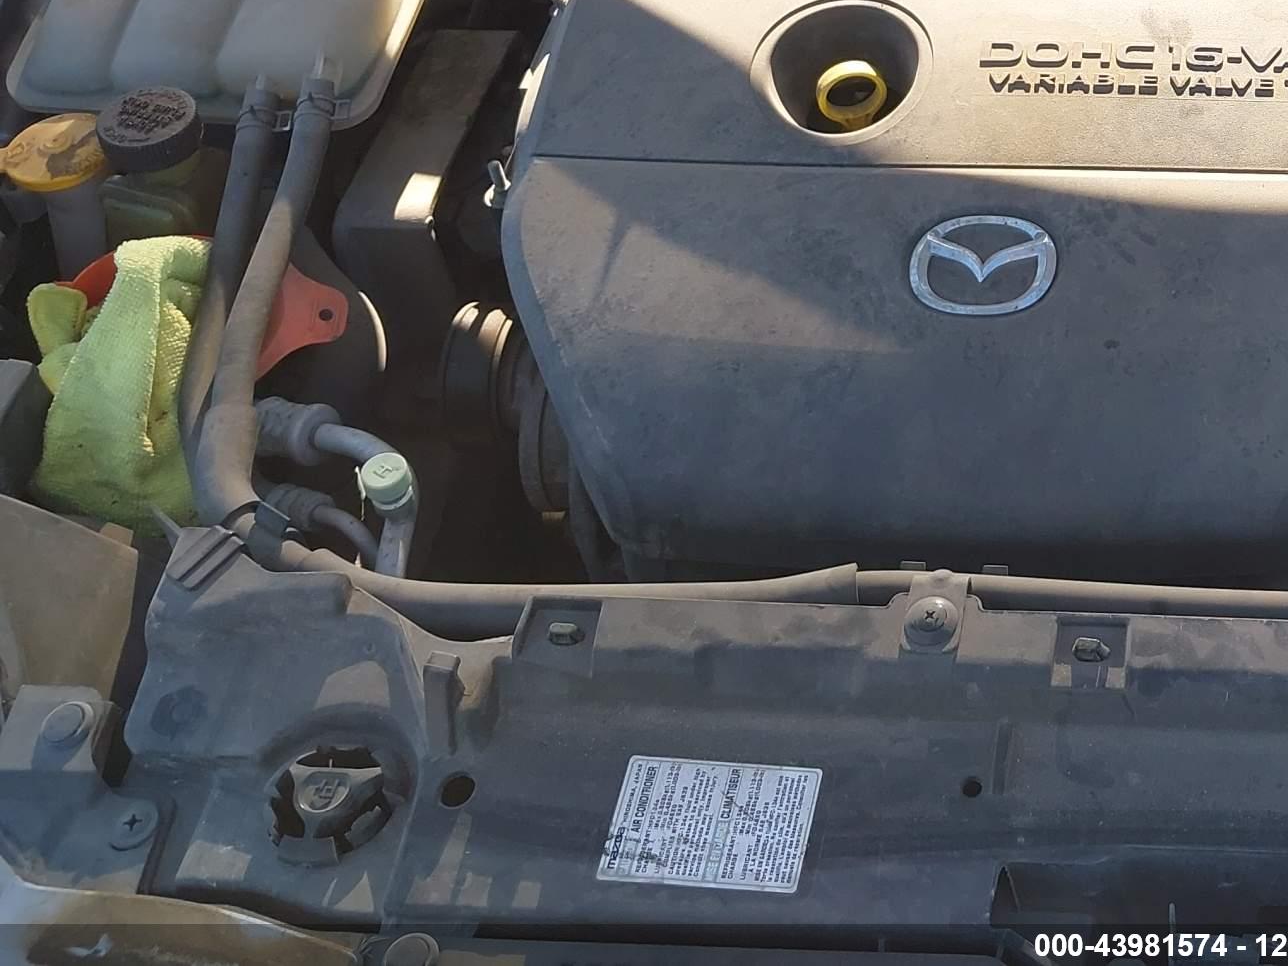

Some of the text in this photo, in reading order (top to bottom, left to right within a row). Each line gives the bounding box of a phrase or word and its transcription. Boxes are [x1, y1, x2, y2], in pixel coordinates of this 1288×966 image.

[979, 41, 1155, 71] DOHC
[988, 73, 1158, 96] VARIABLE
[1169, 75, 1275, 98] VALVE
[629, 765, 658, 832] AIR CONDITIONER
[719, 768, 742, 819] CLIMATISEUR
[605, 826, 625, 869] mazda
